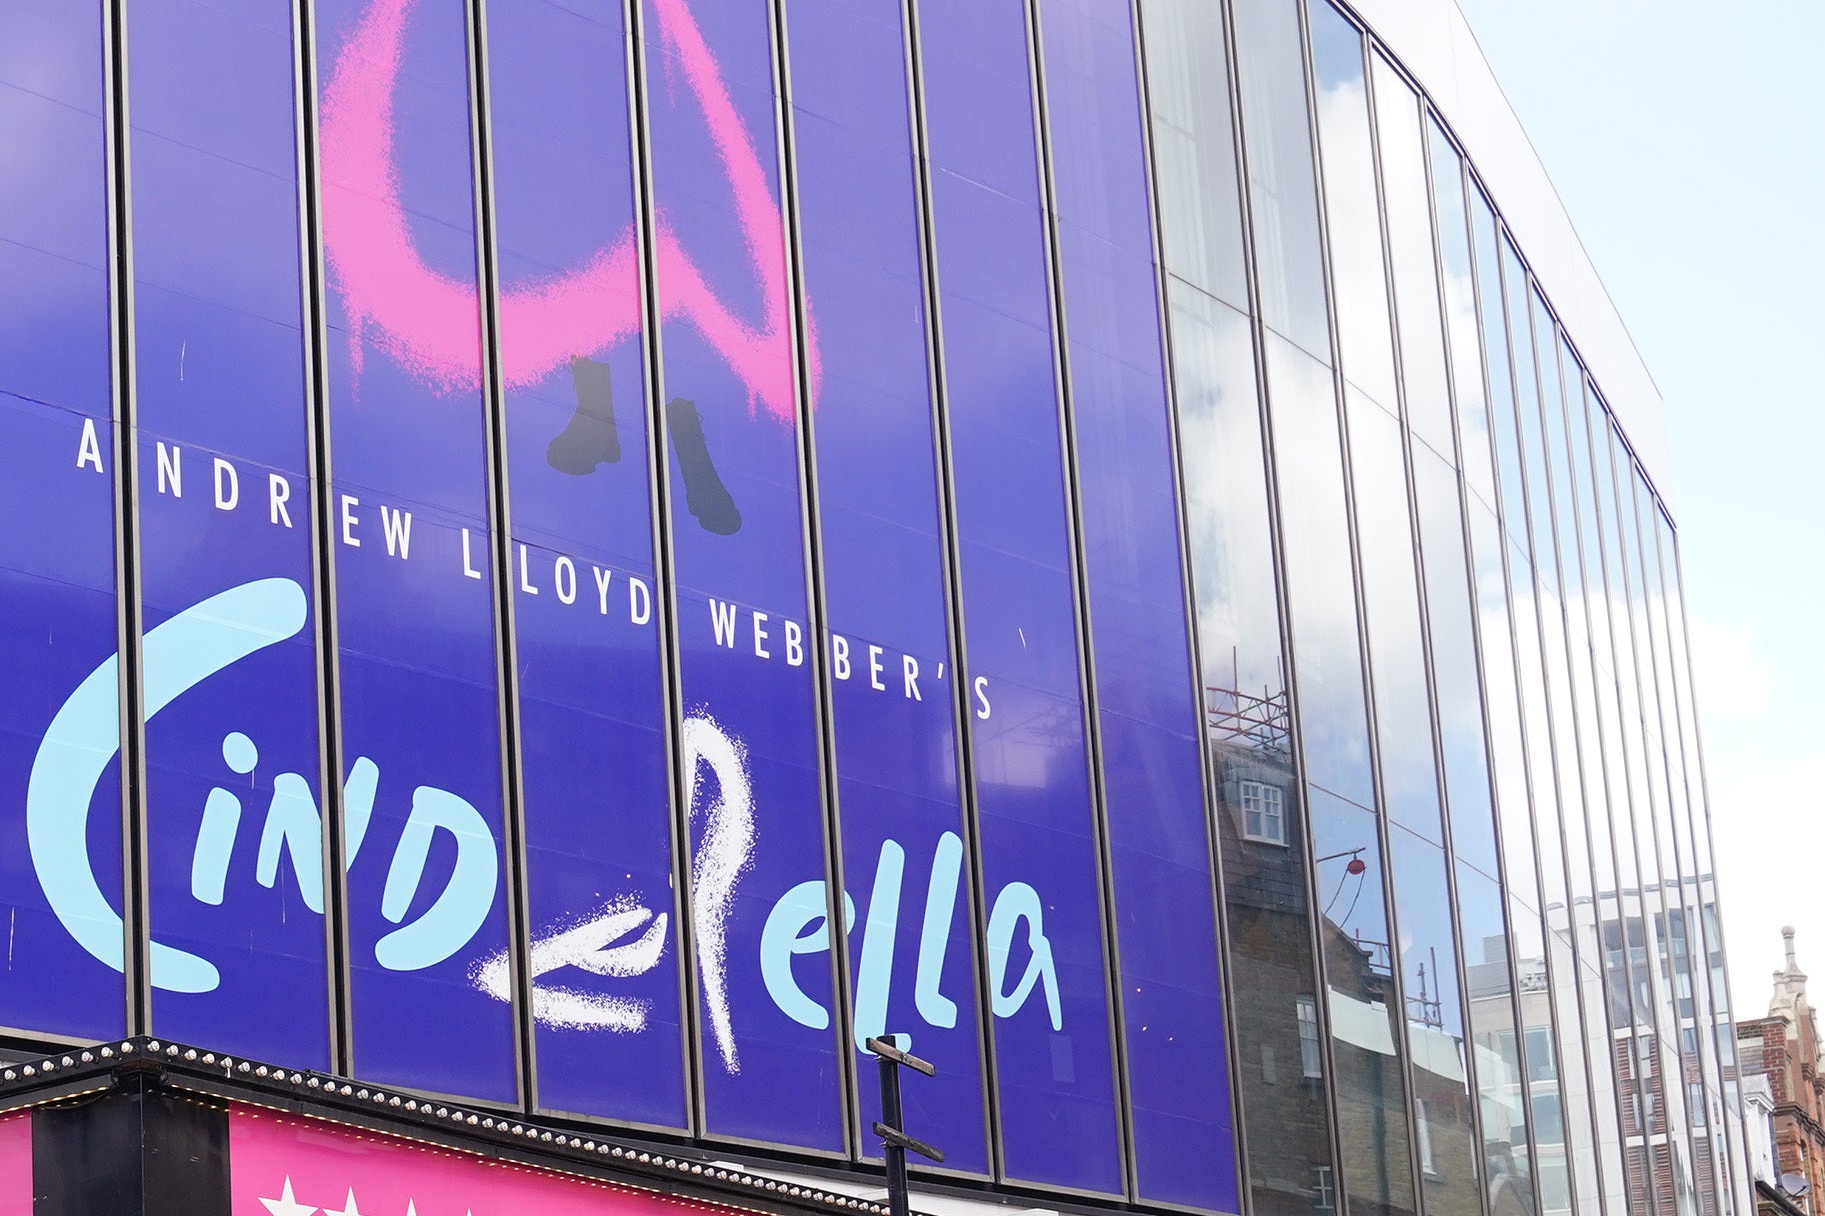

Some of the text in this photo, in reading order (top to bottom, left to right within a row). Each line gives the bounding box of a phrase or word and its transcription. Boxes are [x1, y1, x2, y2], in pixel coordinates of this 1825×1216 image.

[77, 417, 992, 720] ANDREW LLOYD WEBBER'S
